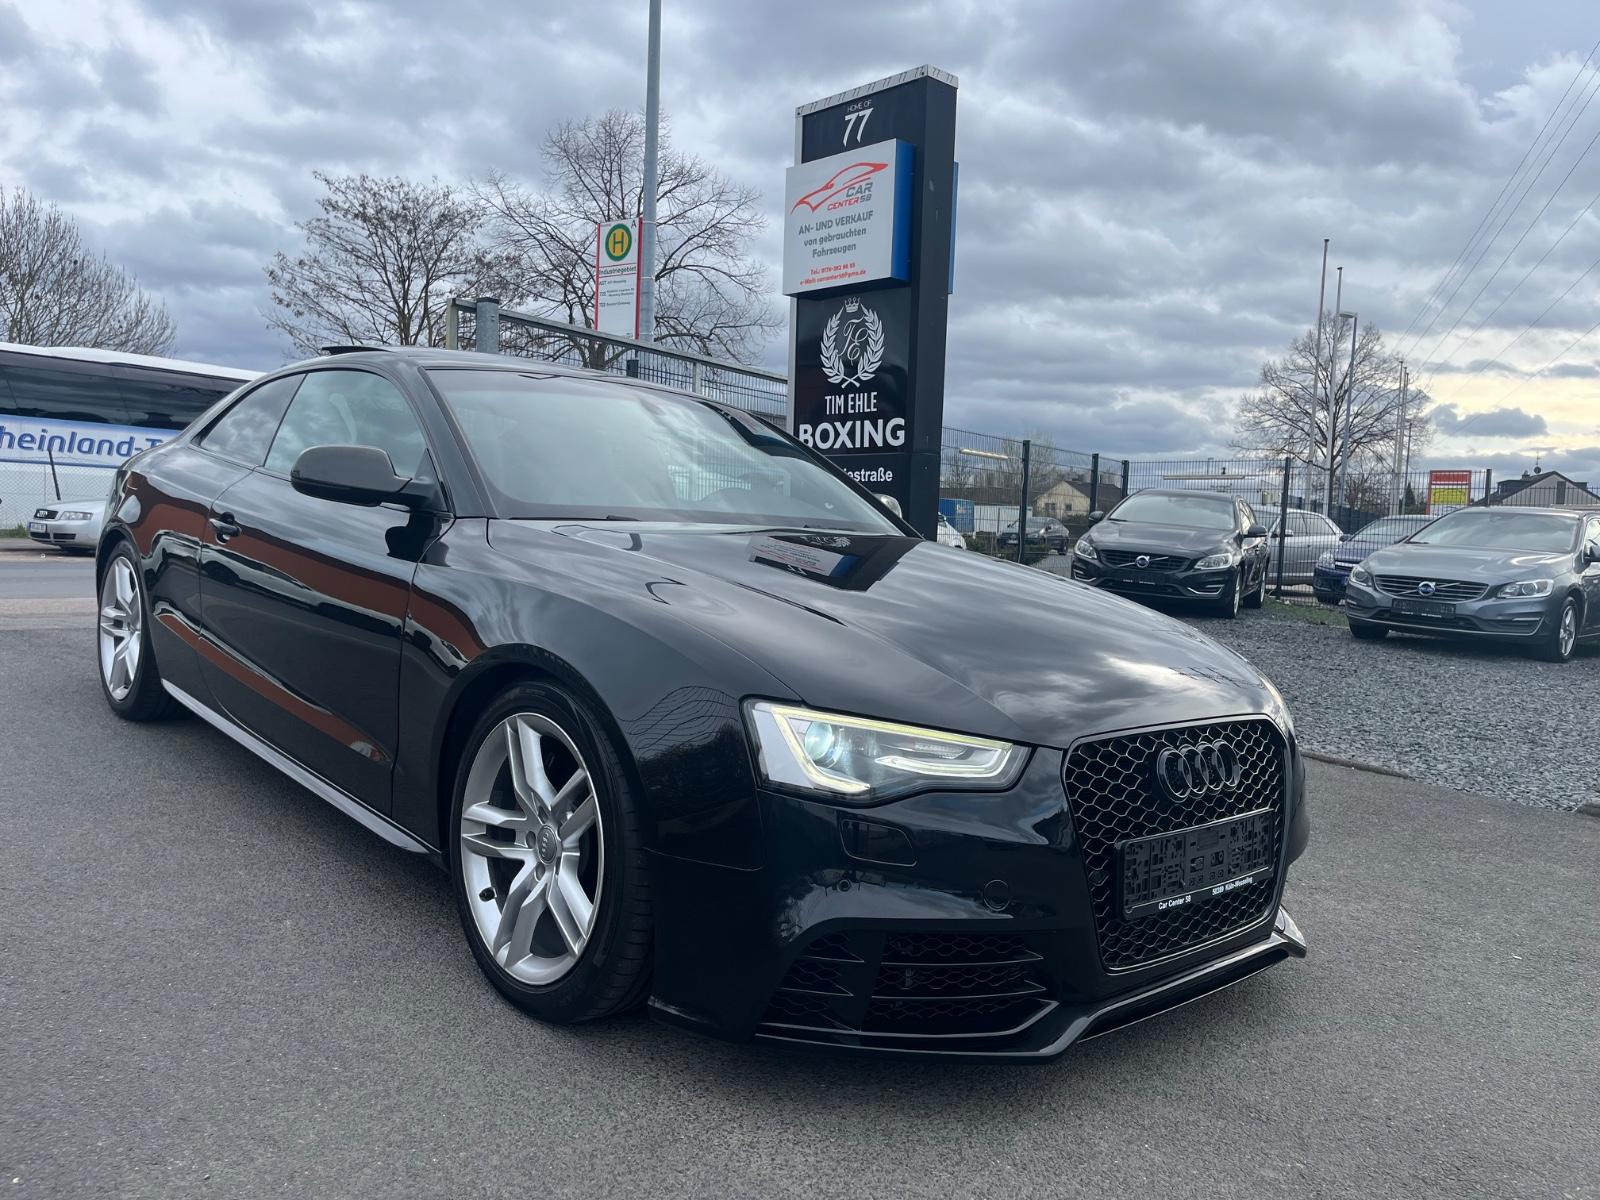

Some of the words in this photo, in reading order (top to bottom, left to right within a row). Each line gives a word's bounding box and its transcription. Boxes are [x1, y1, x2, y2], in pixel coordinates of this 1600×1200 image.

[847, 102, 863, 112] HOME
[863, 99, 872, 108] OF
[843, 107, 874, 147] 77
[846, 182, 873, 198] CAR
[630, 220, 637, 229] A
[799, 223, 814, 236] AN-
[815, 219, 833, 232] UND
[835, 210, 873, 226] VERKAUF
[612, 231, 625, 253] H
[803, 238, 818, 247] von
[819, 227, 867, 245] gebrauchten
[812, 243, 857, 258] Fahrzeugen
[825, 394, 844, 415] TIM
[847, 391, 878, 414] EHLE
[799, 417, 905, 450] BOXING
[1158, 901, 1168, 910] Car
[1168, 897, 1185, 907] Center
